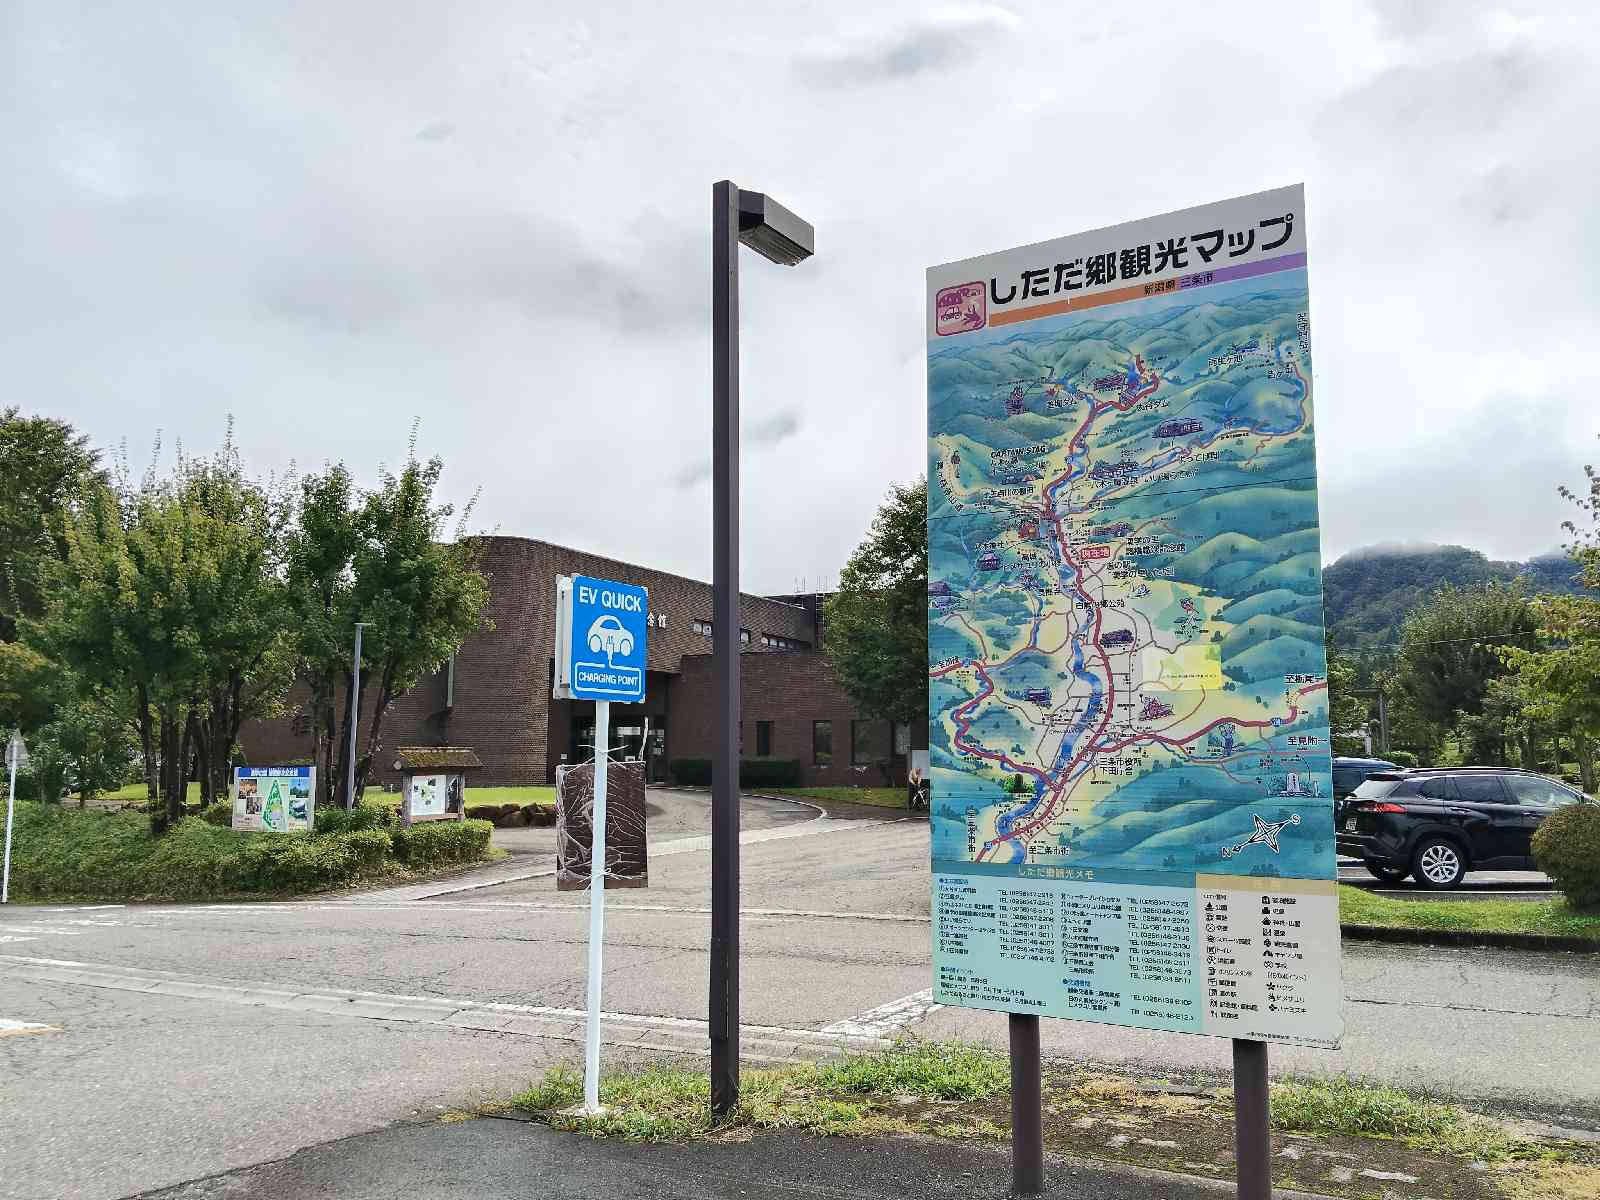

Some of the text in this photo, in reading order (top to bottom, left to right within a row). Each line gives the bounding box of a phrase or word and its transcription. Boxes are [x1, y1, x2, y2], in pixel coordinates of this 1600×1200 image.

[990, 213, 1294, 305] しただ郷観光マップ
[1144, 272, 1213, 295] 新潟県 三条市
[579, 586, 642, 612] EV QUICK
[578, 671, 639, 687] CHARGING POINT
[1099, 757, 1142, 766] 三条市役所
